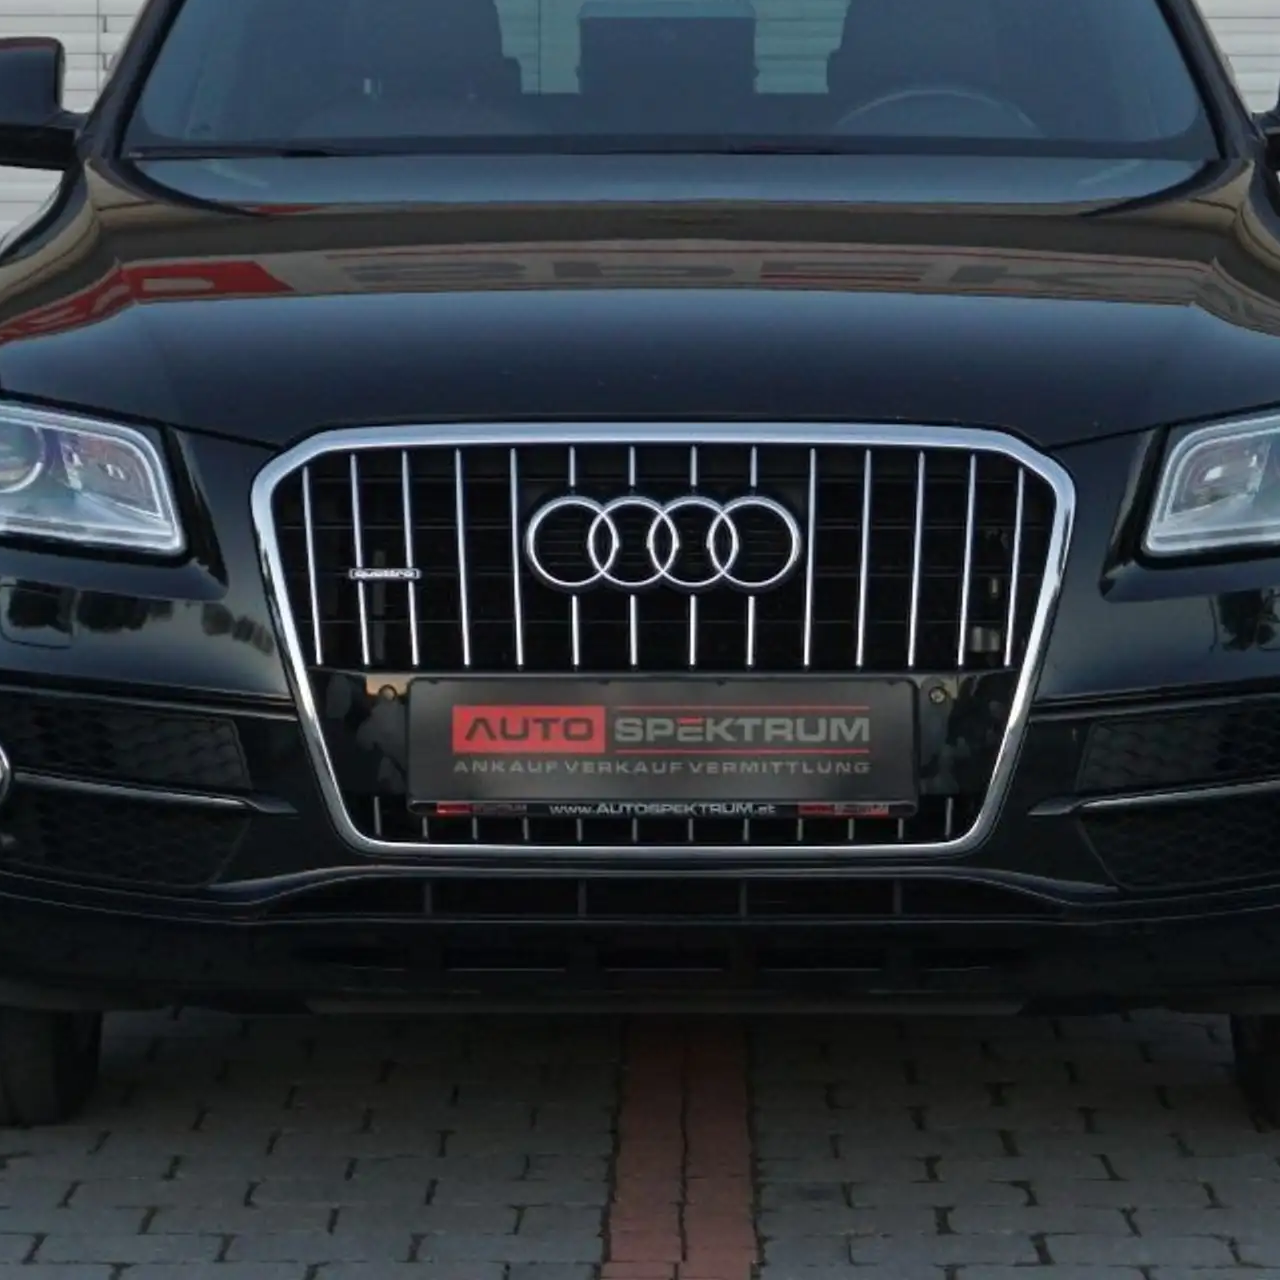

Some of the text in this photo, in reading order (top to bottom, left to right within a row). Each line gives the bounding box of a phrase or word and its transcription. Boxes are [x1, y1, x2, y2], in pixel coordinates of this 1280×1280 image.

[464, 716, 870, 742] AUTO SPEKTRUM
[454, 759, 871, 774] ANKAUF VERKAUF VERMITTLUNG
